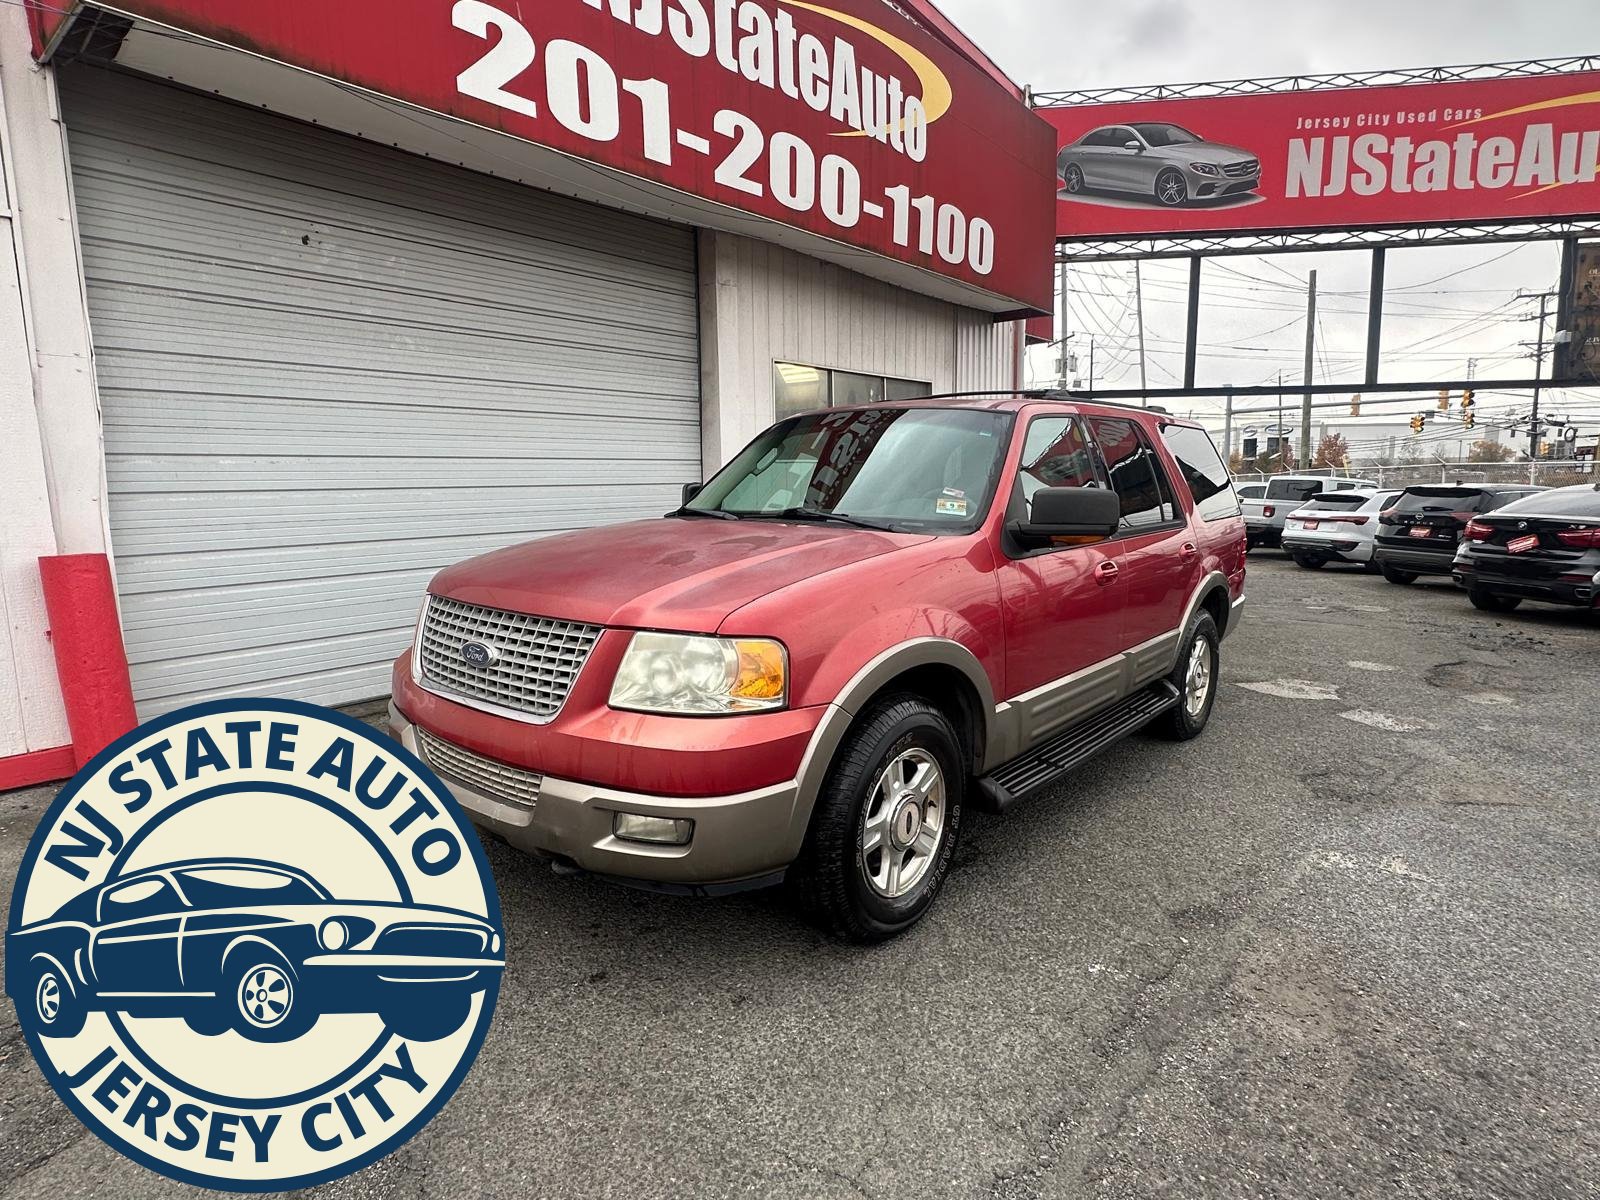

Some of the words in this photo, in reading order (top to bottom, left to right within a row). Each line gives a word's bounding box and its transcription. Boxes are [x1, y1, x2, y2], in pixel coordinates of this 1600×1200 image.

[582, 0, 928, 163] StateAuto
[451, 0, 995, 275] 201-200-1100
[1296, 116, 1350, 130] Jersey
[1356, 113, 1390, 127] City
[1396, 109, 1436, 125] Used
[1444, 108, 1482, 121] Cars
[466, 645, 485, 662] Ford
[923, 832, 956, 899] RADIAL
